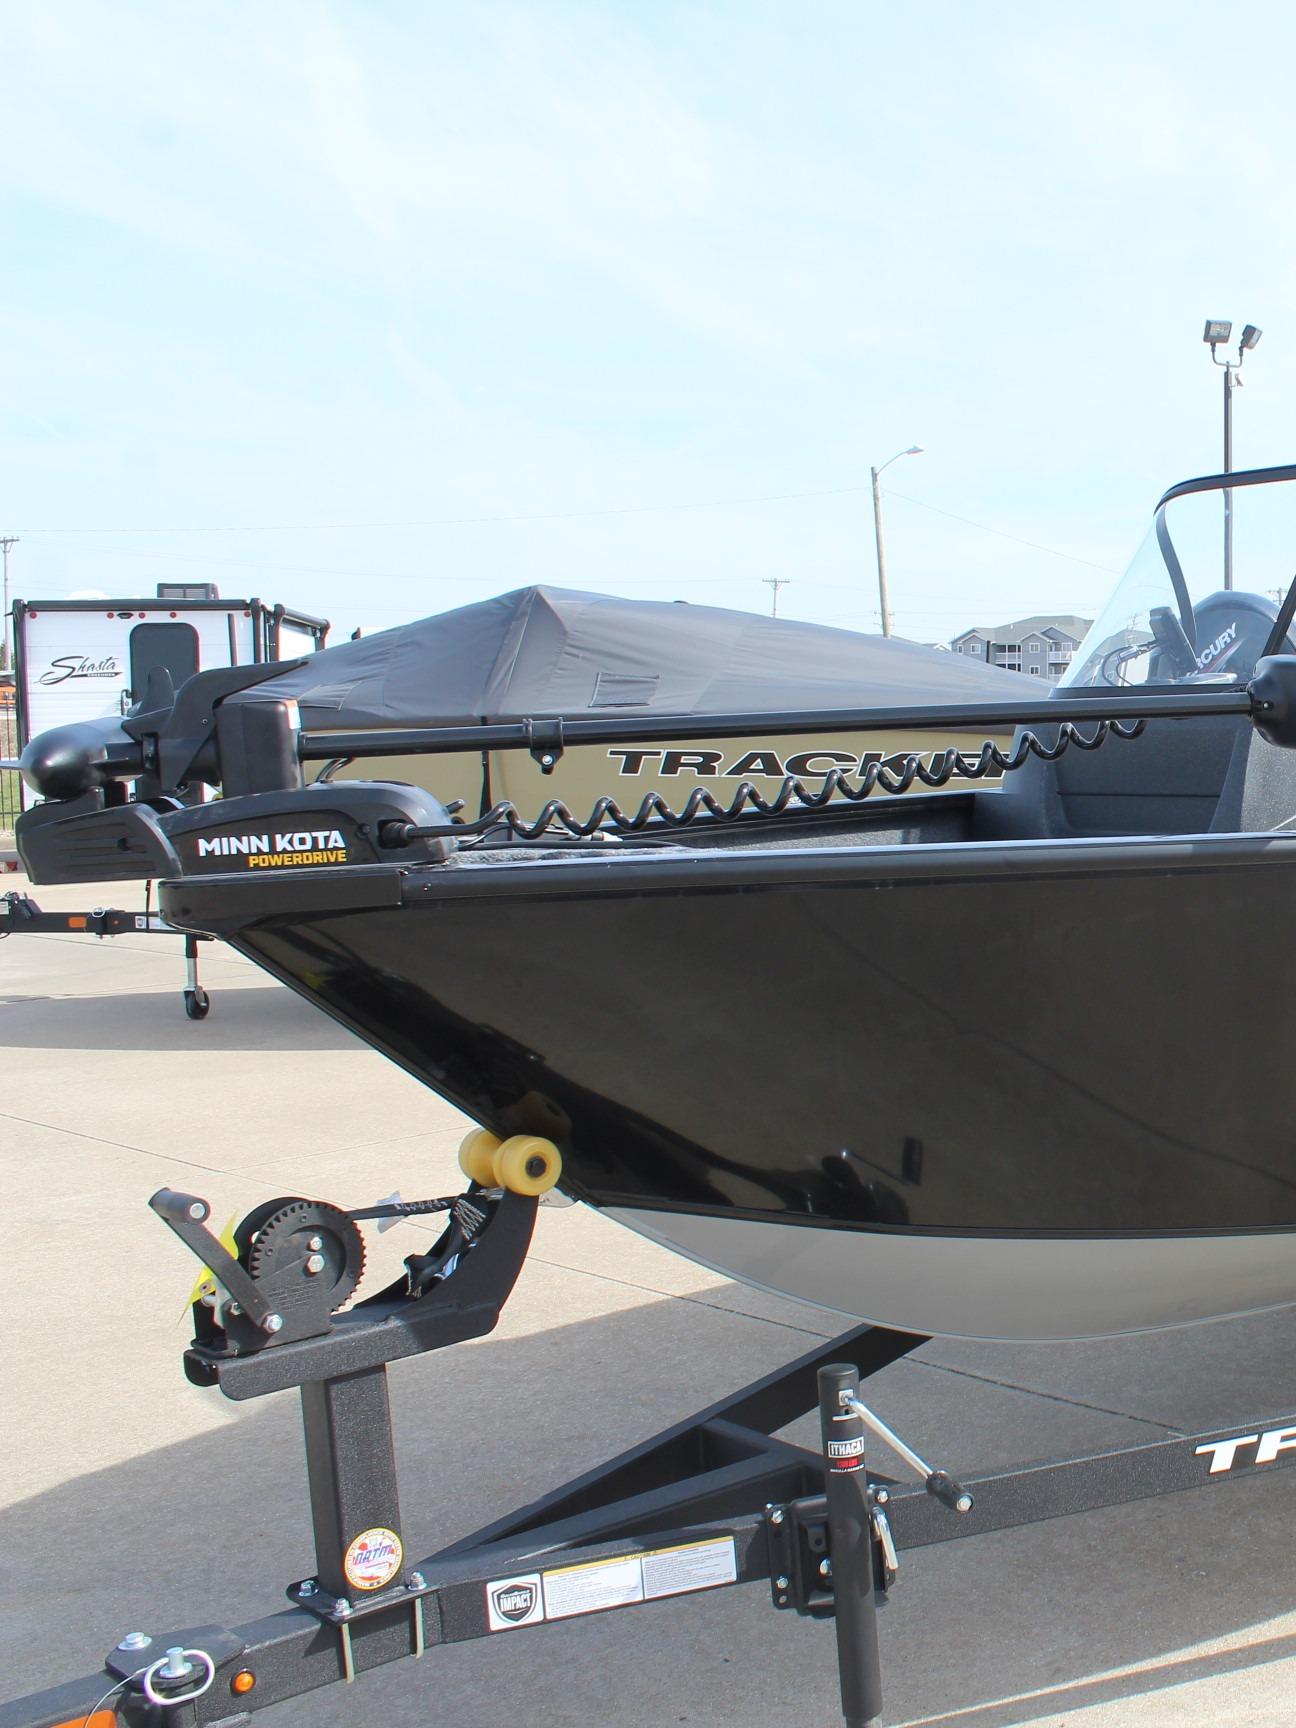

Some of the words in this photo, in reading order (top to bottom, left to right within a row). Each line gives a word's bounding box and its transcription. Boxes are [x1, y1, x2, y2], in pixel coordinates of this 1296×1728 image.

[33, 655, 121, 686] Shasta
[198, 834, 270, 857] MINN
[275, 830, 346, 852] KOTA
[248, 849, 347, 867] POWERDRIVE
[830, 1440, 862, 1456] ITHACA
[500, 1593, 531, 1612] IMPACT
